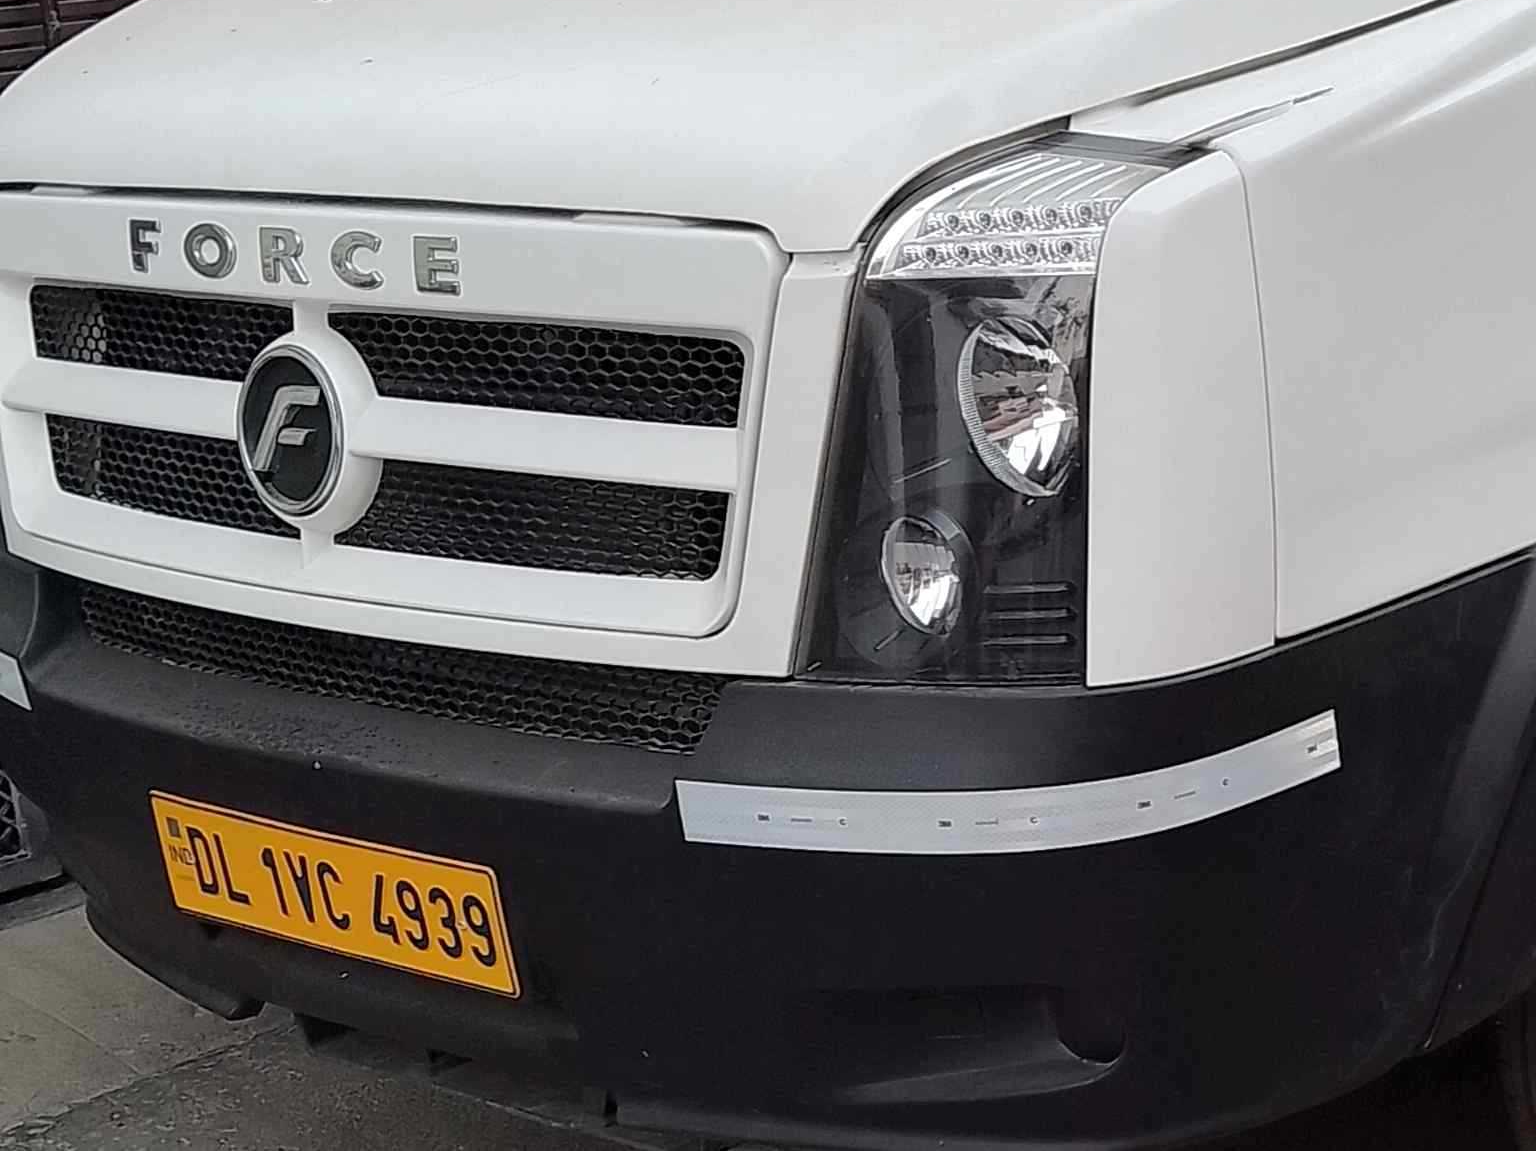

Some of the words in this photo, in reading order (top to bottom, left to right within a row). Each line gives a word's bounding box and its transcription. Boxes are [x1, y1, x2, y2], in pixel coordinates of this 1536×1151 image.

[129, 219, 461, 296] FORCE
[168, 843, 195, 866] IND
[186, 825, 252, 905] DL
[260, 847, 350, 931] 1VC
[373, 873, 498, 967] 4939
